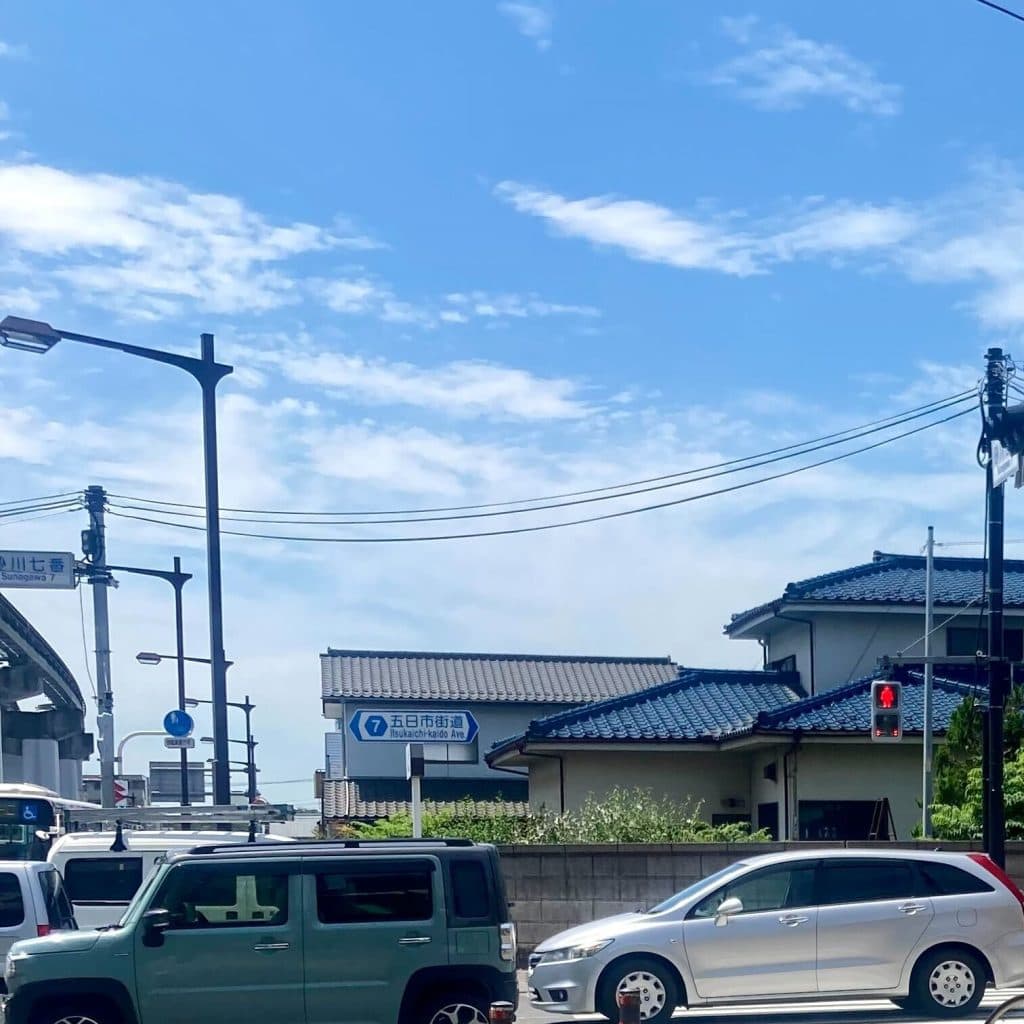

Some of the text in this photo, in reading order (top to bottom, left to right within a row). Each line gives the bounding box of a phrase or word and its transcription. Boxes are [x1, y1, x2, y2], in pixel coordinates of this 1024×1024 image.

[2, 572, 56, 582] Sunagawa 7
[371, 719, 380, 733] 7
[390, 714, 463, 728] 五日市街道
[390, 729, 448, 739] Itsukaichi-kaido
